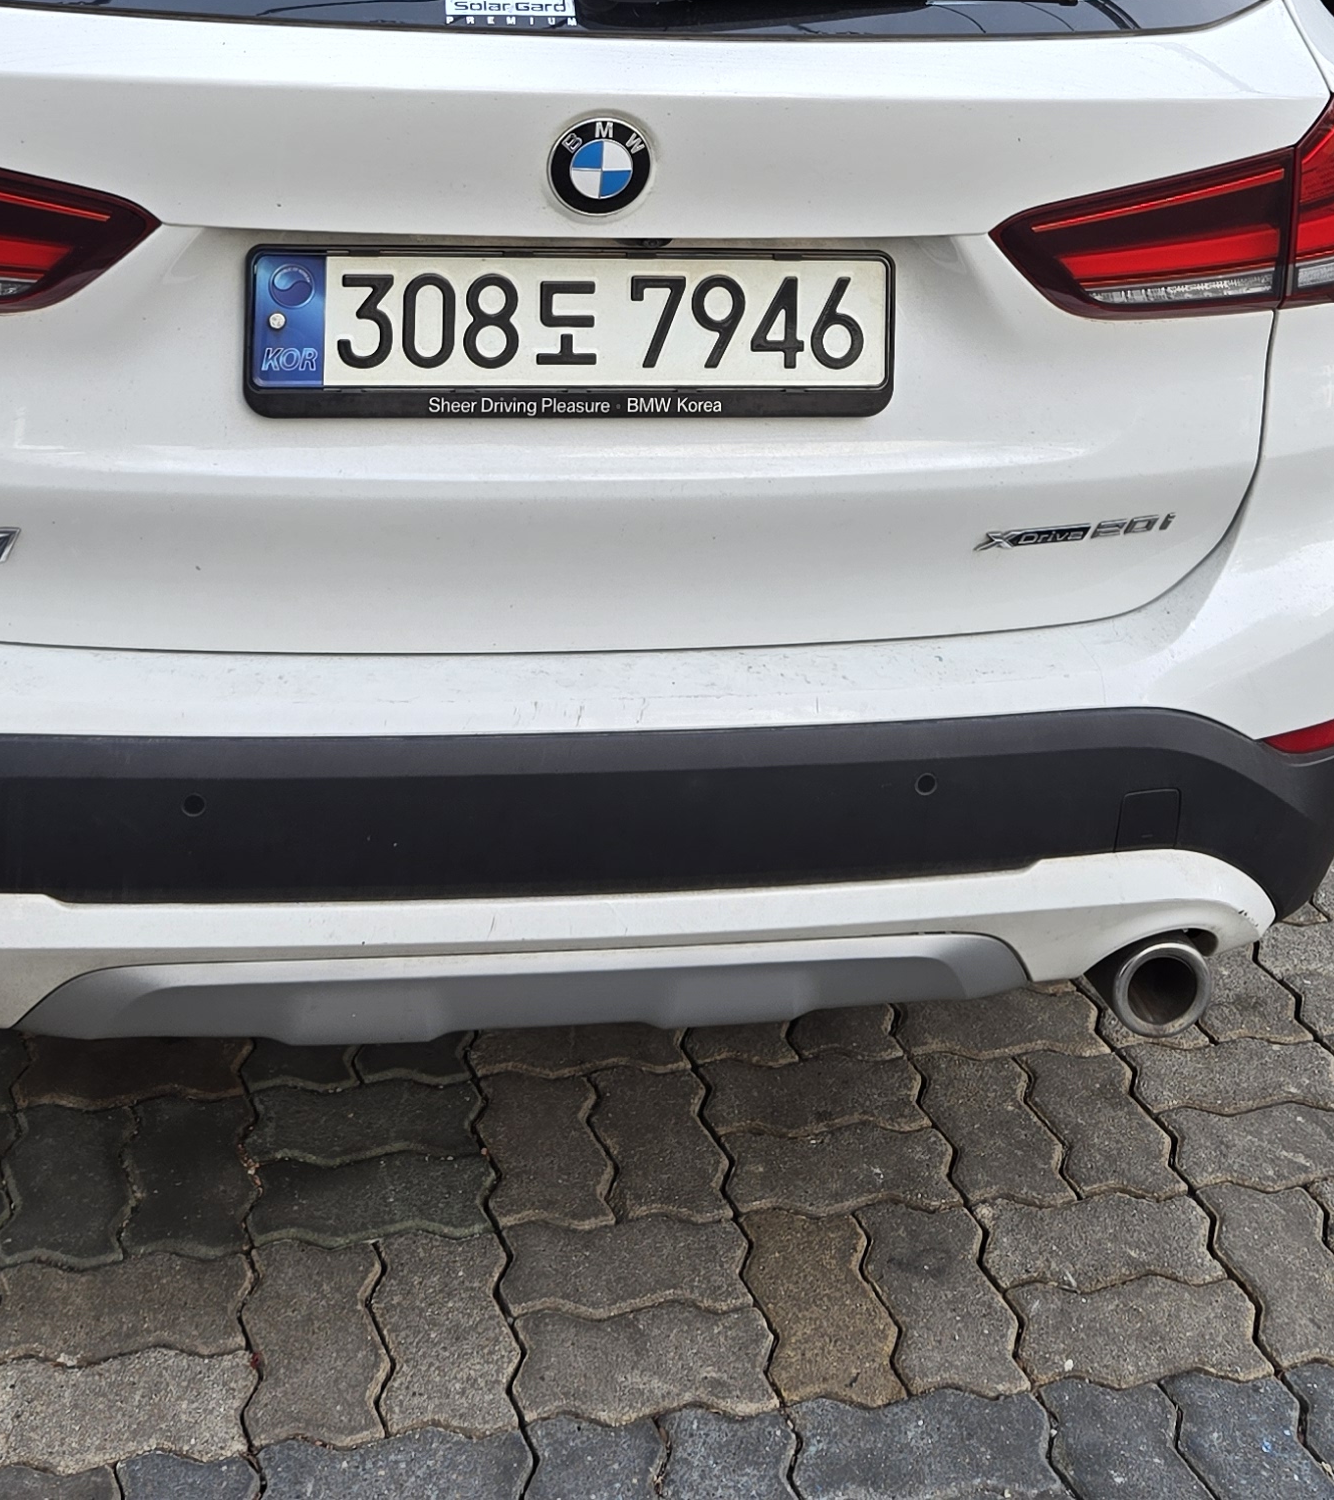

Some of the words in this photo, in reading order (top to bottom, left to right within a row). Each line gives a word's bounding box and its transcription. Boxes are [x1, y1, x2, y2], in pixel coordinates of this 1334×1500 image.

[454, 0, 511, 12] Solar
[445, 16, 578, 27] PREMIUM
[562, 121, 646, 154] BMW
[336, 272, 597, 369] 308도
[630, 274, 864, 370] 7946
[261, 347, 318, 371] KOR
[428, 398, 477, 414] Sheer
[481, 397, 538, 417] Driving
[541, 398, 610, 414] Pleasure
[627, 398, 672, 414] BMW
[677, 398, 722, 414] Korea
